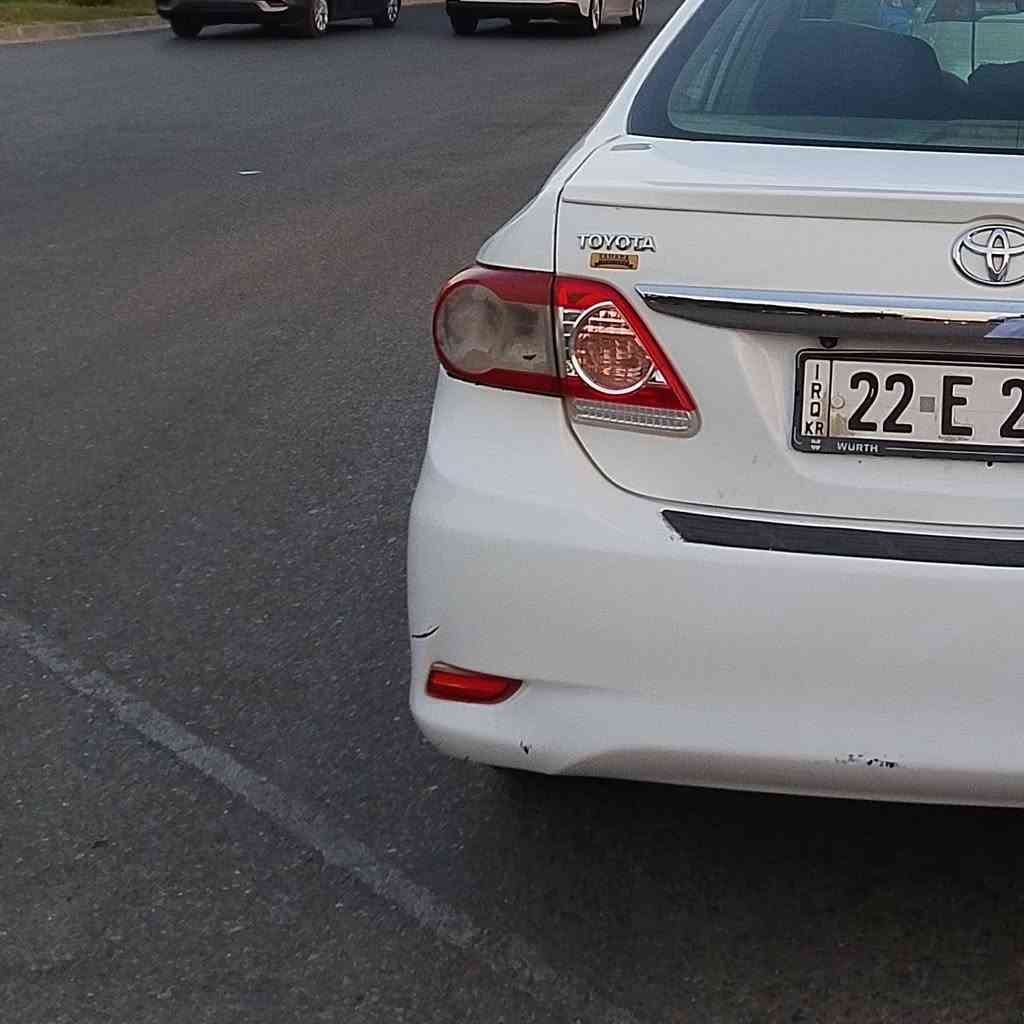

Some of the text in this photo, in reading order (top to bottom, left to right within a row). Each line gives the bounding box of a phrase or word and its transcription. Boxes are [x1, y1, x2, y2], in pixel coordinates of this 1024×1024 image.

[578, 234, 656, 253] TOYOTA
[848, 371, 914, 434] 22
[940, 375, 975, 436] E
